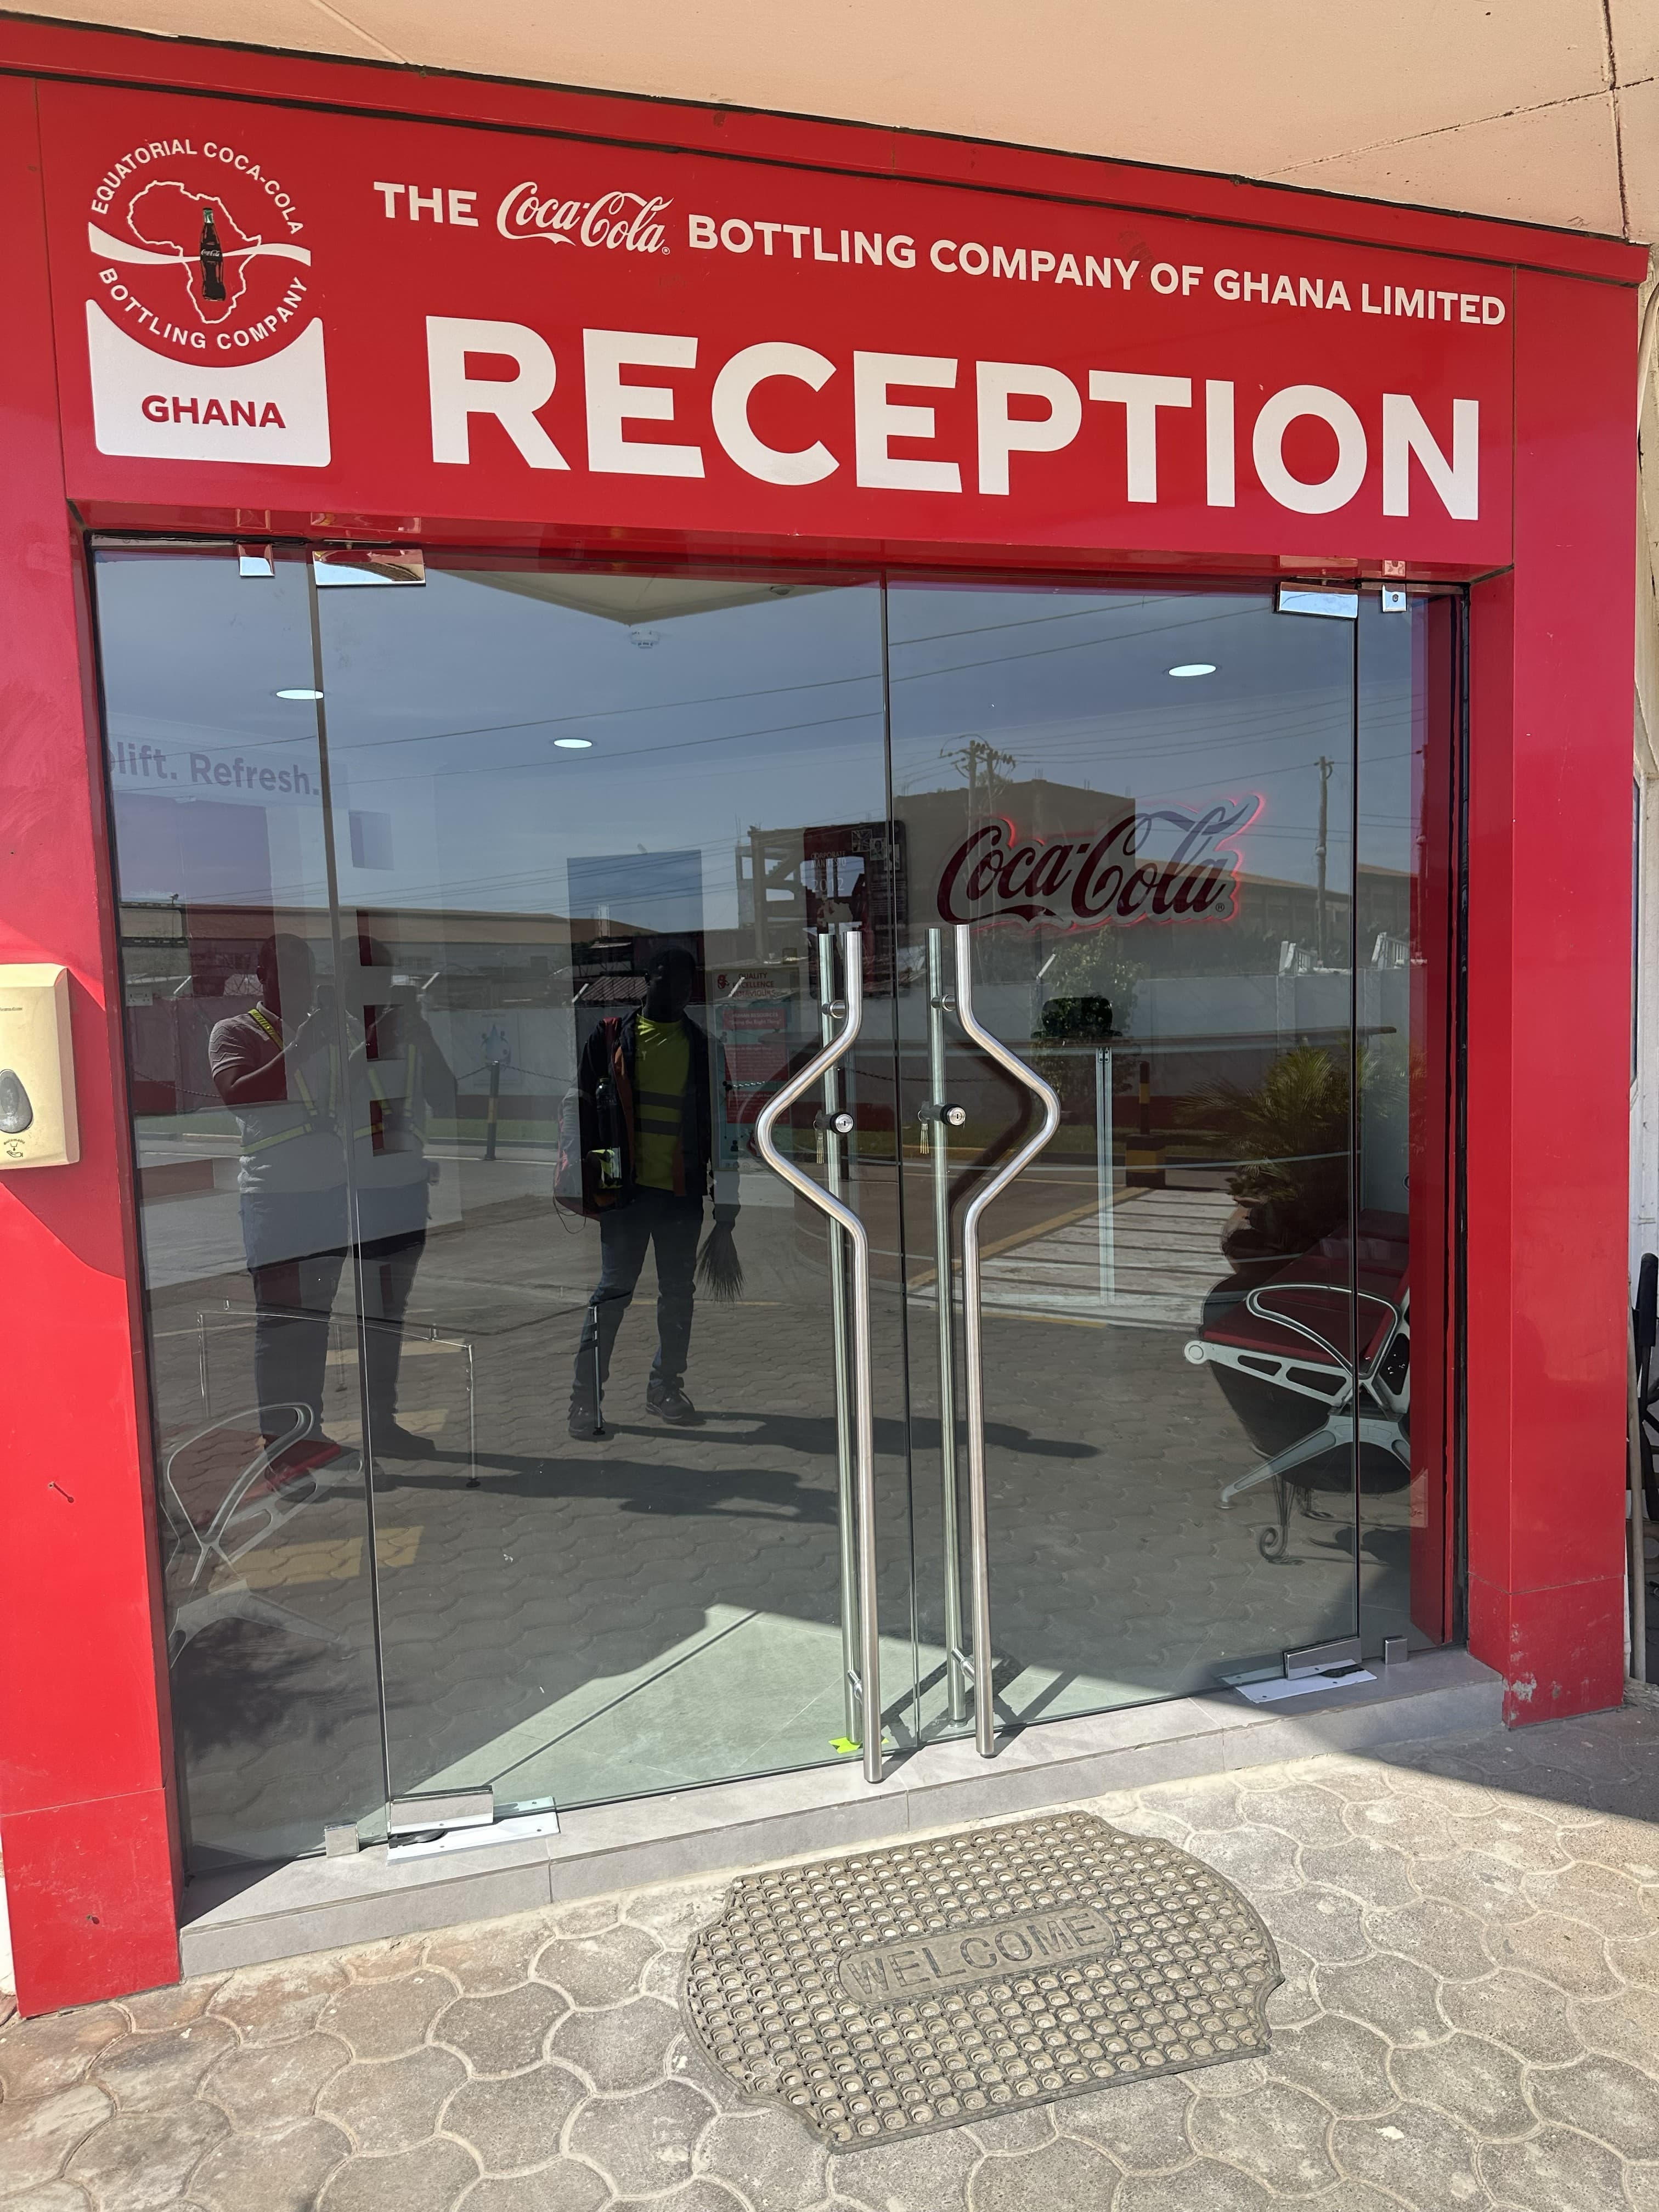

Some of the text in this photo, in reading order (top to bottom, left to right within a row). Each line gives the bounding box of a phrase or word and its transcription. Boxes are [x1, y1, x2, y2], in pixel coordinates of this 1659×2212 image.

[91, 138, 304, 235] EQUATORIAL COCA-COLA
[373, 180, 1505, 325] THE Coca-Cola BOTTLING COMPANY OF GHANA LIMITED
[99, 267, 308, 350] BOTTLING COMPANY
[141, 394, 287, 429] GHANA
[425, 315, 1480, 521] RECEPTION
[190, 752, 319, 795] Refresh.
[812, 877, 844, 892] 2012
[937, 803, 1250, 925] Coca-Cola
[733, 980, 774, 989] ECELLENCE
[847, 1912, 1107, 1995] WELCOME
